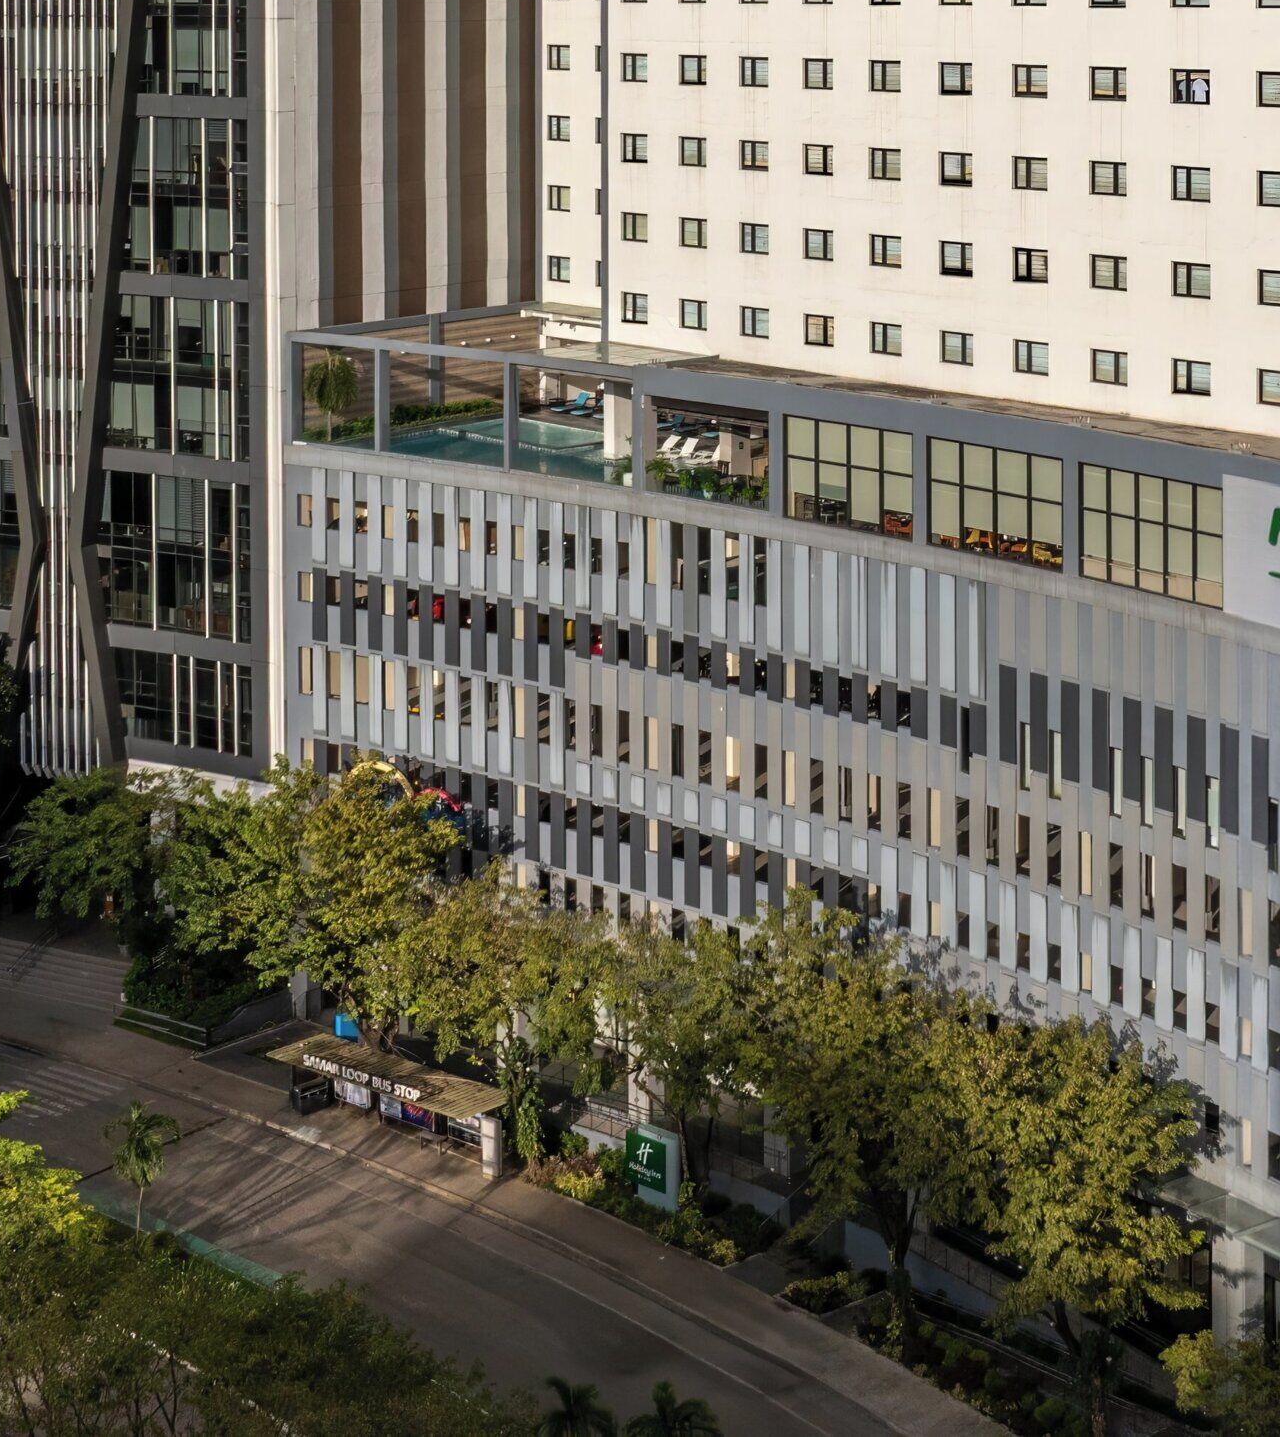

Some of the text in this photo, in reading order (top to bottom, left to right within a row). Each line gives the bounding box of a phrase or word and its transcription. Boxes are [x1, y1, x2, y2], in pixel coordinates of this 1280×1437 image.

[303, 1054, 421, 1102] SAMAR LOOP BUS STOP
